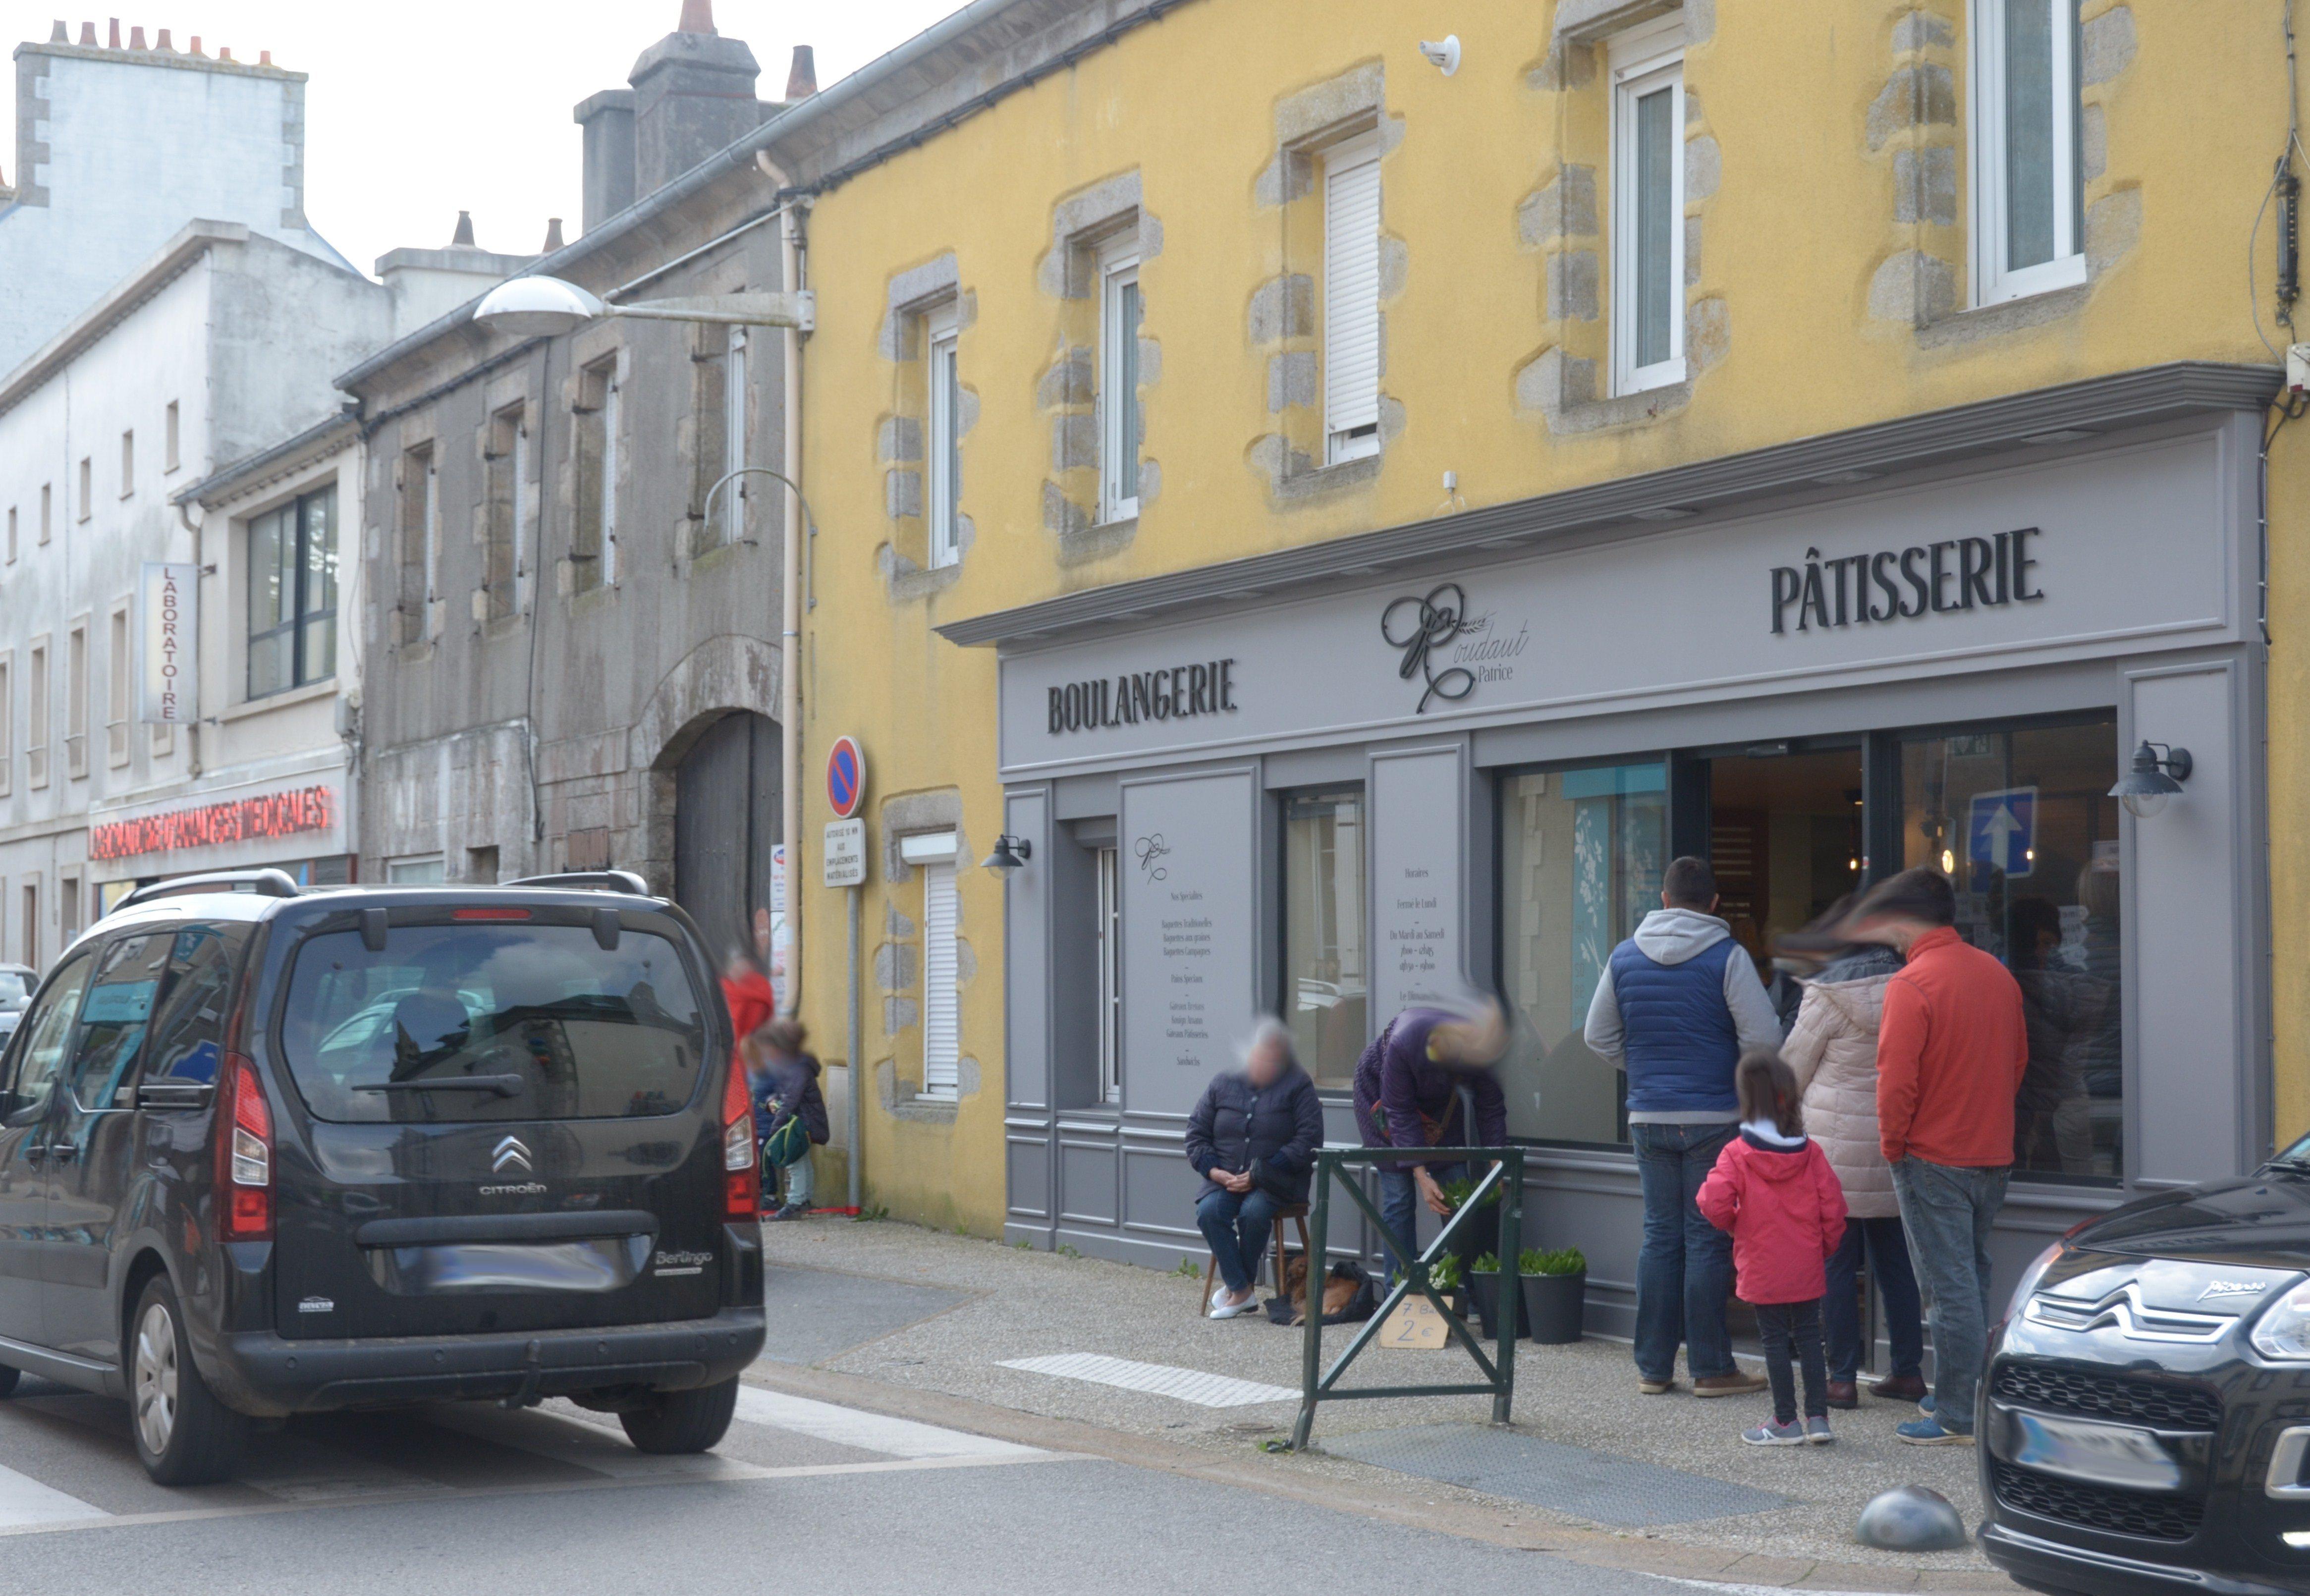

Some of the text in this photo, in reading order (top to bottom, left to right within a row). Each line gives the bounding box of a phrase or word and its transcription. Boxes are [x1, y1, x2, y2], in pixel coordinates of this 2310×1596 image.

[1769, 526, 2044, 634] PÂTISSERIE
[162, 567, 178, 719] LABORATOIRE
[1478, 664, 1513, 683] Patrice
[1047, 659, 1237, 734] BOULANGERIE
[826, 855, 858, 867] EMPLACEMENTS
[1405, 868, 1429, 879] Horaires
[1397, 897, 1437, 909] Fermé le Lundi
[1390, 930, 1397, 940] Du
[1398, 928, 1415, 940] Mardi
[1424, 928, 1445, 939] Samedi
[656, 1251, 713, 1266] Berlingo
[1402, 1303, 1413, 1316] 7
[1397, 1320, 1414, 1341] 2
